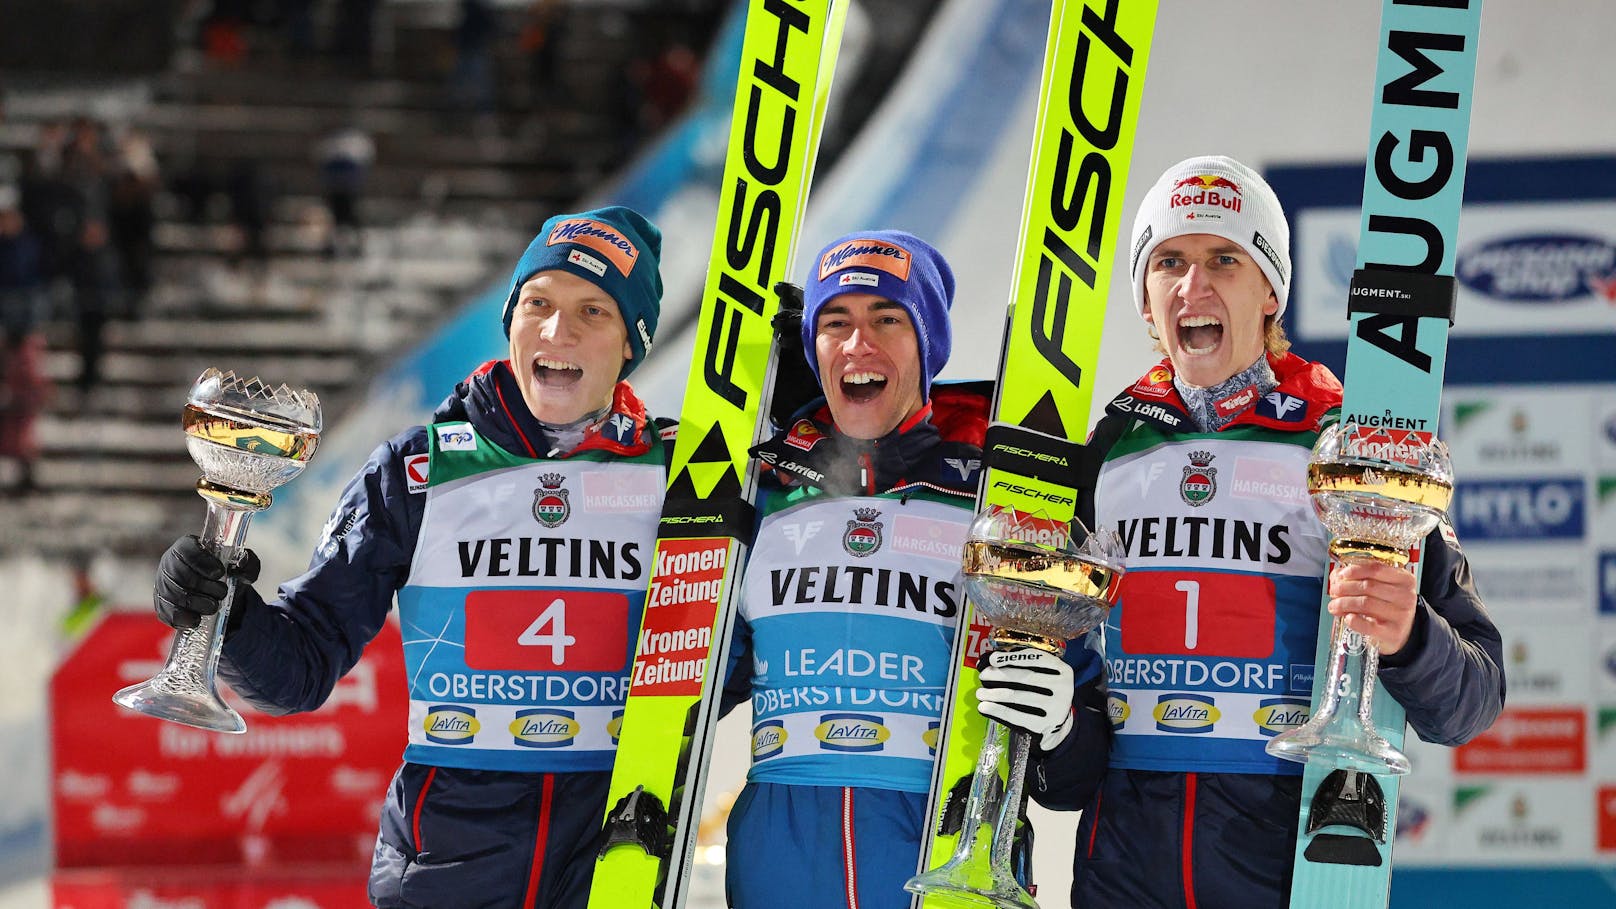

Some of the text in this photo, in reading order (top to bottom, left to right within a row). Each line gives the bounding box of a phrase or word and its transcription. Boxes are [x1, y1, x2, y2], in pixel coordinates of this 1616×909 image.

[1170, 191, 1241, 213] Red Bull
[553, 222, 634, 258] Manner
[589, 260, 604, 272] Austria
[823, 244, 905, 272] Manner
[1346, 413, 1428, 430] AUGMENT
[992, 444, 1061, 464] FISCHER
[993, 481, 1074, 506] FISCHER
[659, 516, 715, 524] FISCHER
[893, 535, 962, 558] HARGASSNE
[1117, 517, 1292, 565] VELTINS
[457, 537, 642, 580] VELTINS
[653, 547, 727, 578] Kronen
[648, 578, 724, 608] Zeitung
[771, 565, 958, 618] VELTINS
[1175, 580, 1199, 649] 1
[517, 598, 576, 666] 4
[637, 625, 711, 657] Kronen
[633, 656, 710, 687] Zeitung
[785, 648, 926, 684] LEADER
[996, 653, 1043, 664] ziener
[1106, 658, 1284, 689] OBERSTDORF
[428, 672, 630, 701] OBERSTDORF
